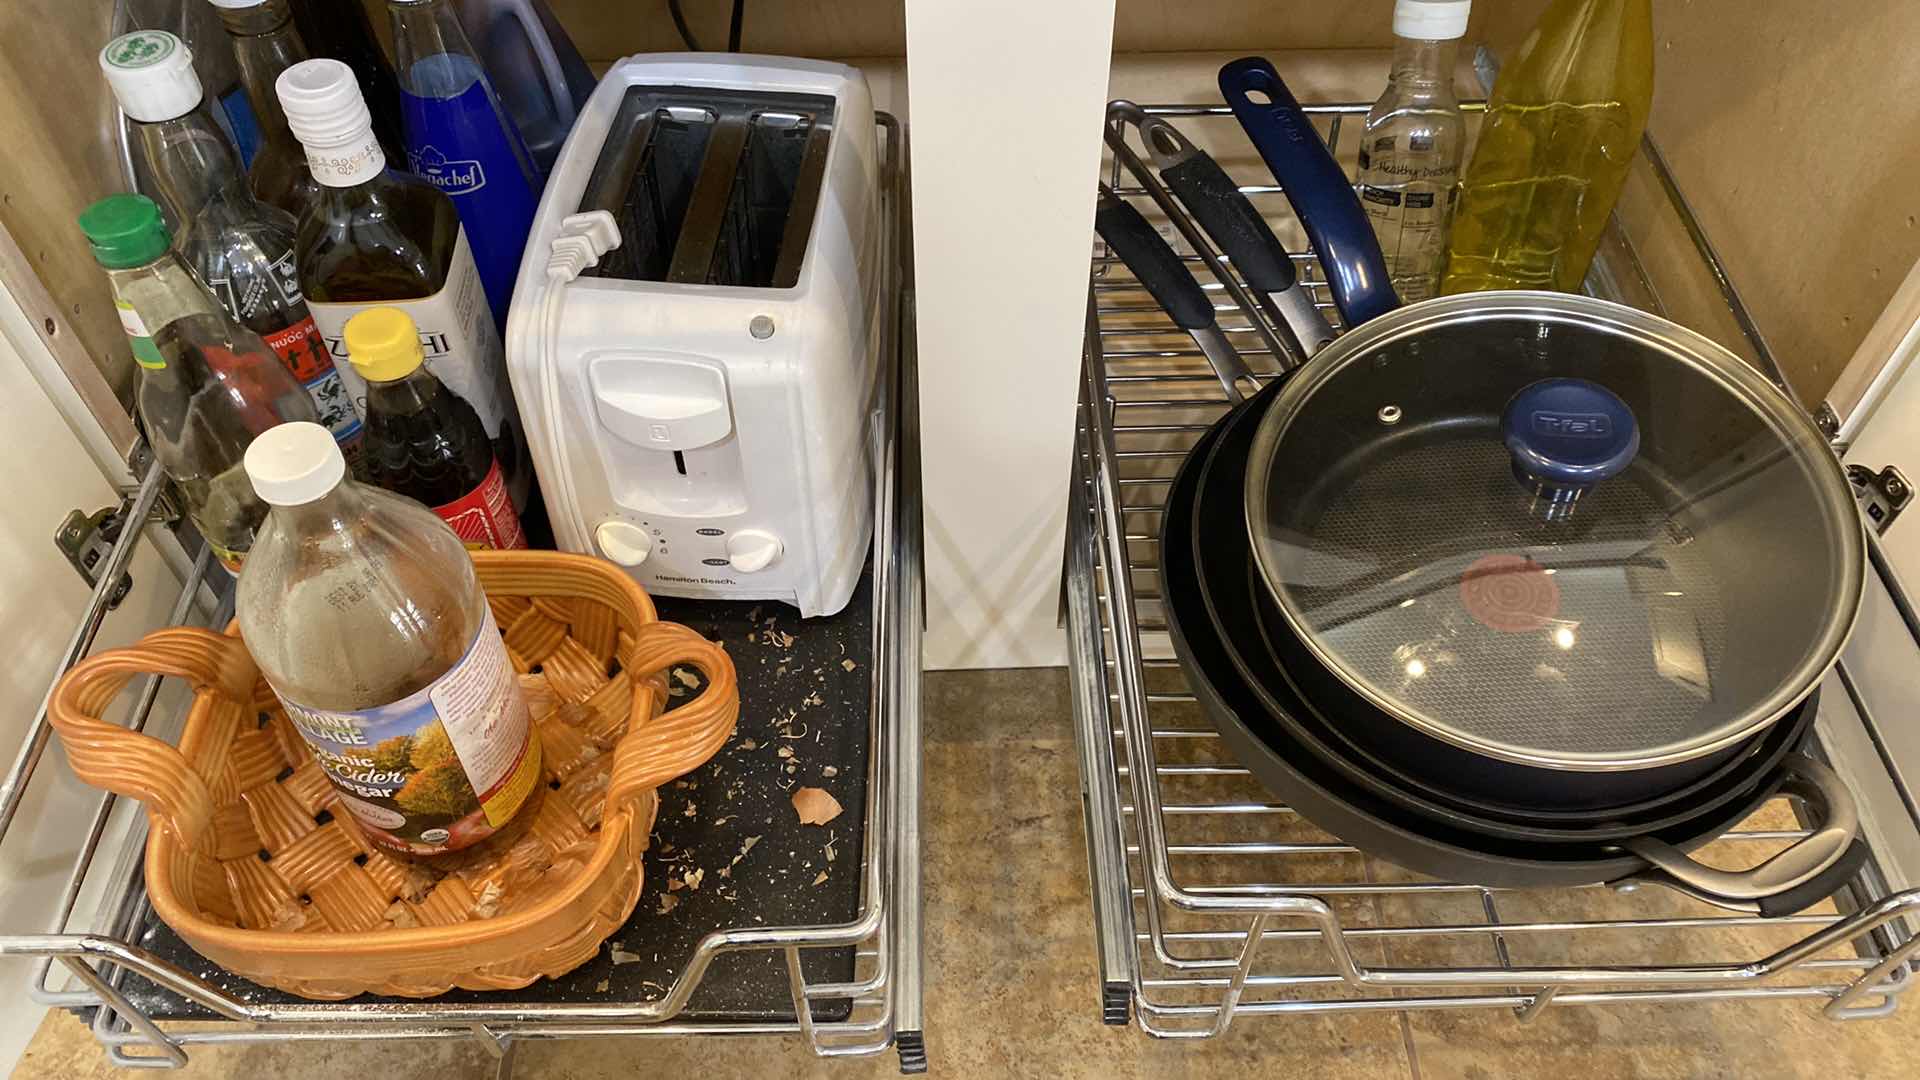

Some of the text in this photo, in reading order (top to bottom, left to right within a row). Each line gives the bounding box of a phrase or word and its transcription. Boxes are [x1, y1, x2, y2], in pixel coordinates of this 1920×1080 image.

[408, 151, 477, 188] Machef
[655, 574, 700, 585] Hamilton
[336, 764, 406, 785] Cider
